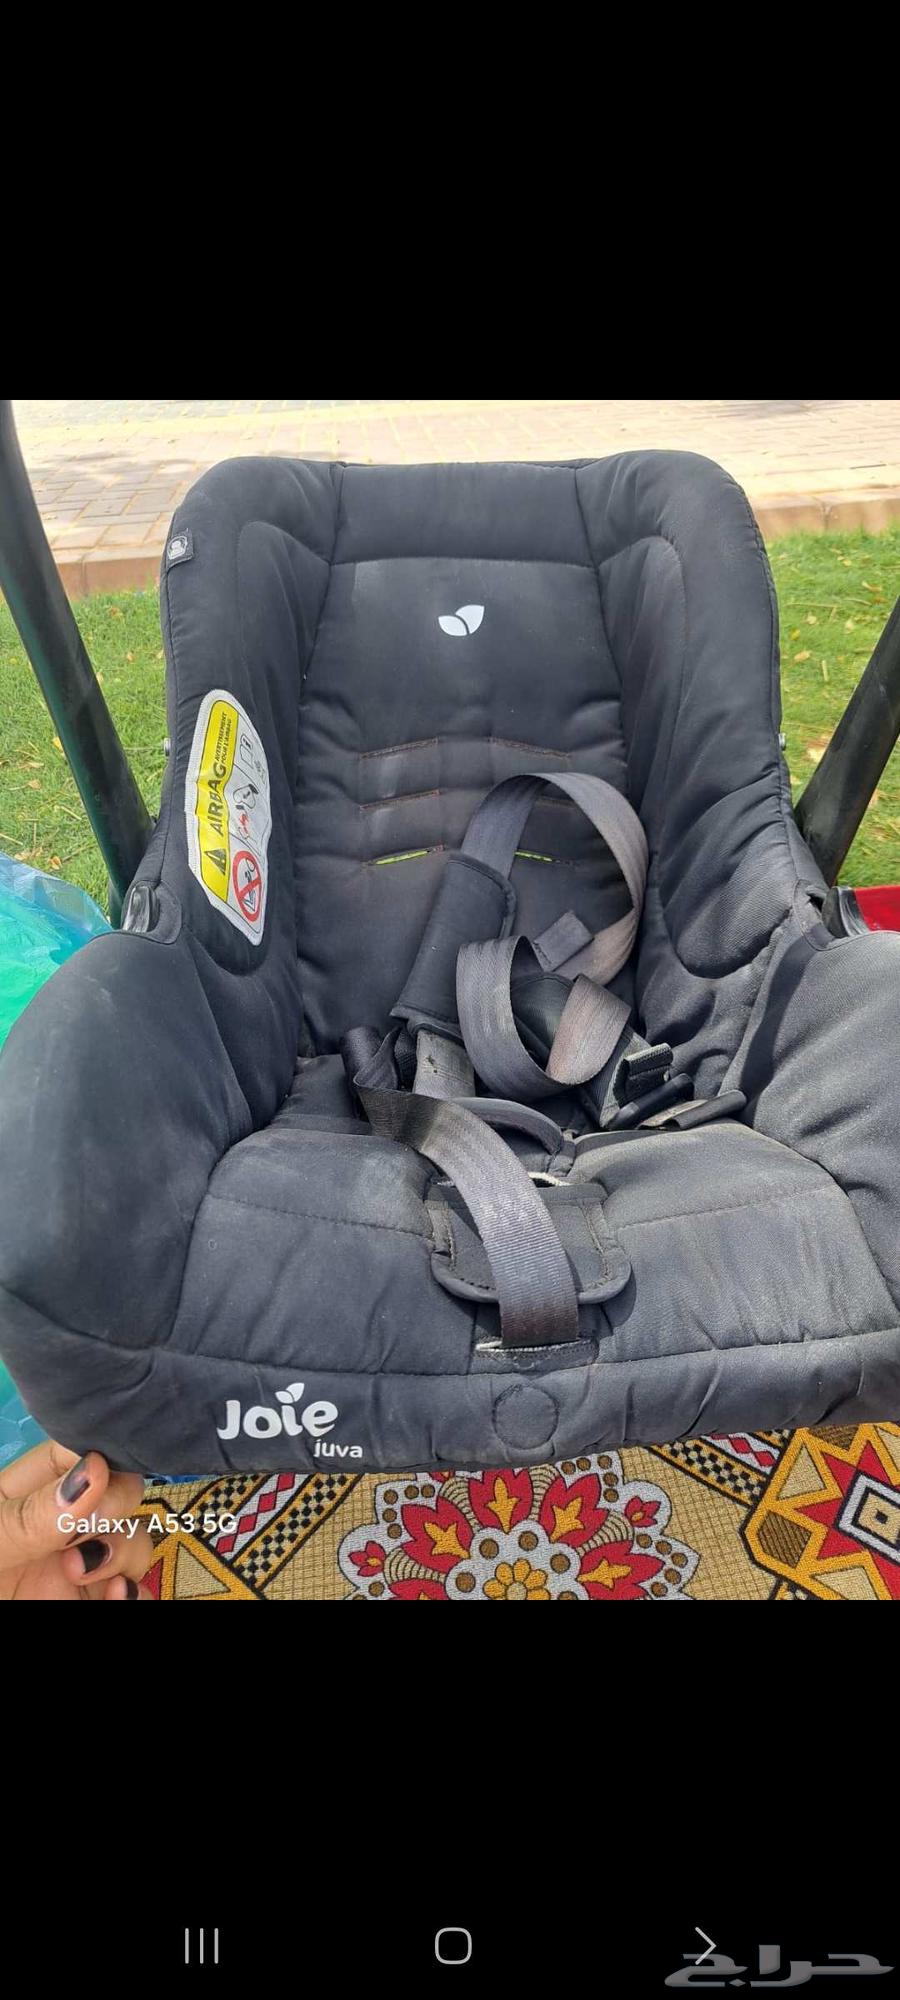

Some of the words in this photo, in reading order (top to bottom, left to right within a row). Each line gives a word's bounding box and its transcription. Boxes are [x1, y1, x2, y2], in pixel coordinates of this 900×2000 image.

[208, 761, 227, 836] AIRBAG
[216, 1383, 338, 1439] Joie
[313, 1439, 363, 1458] juva
